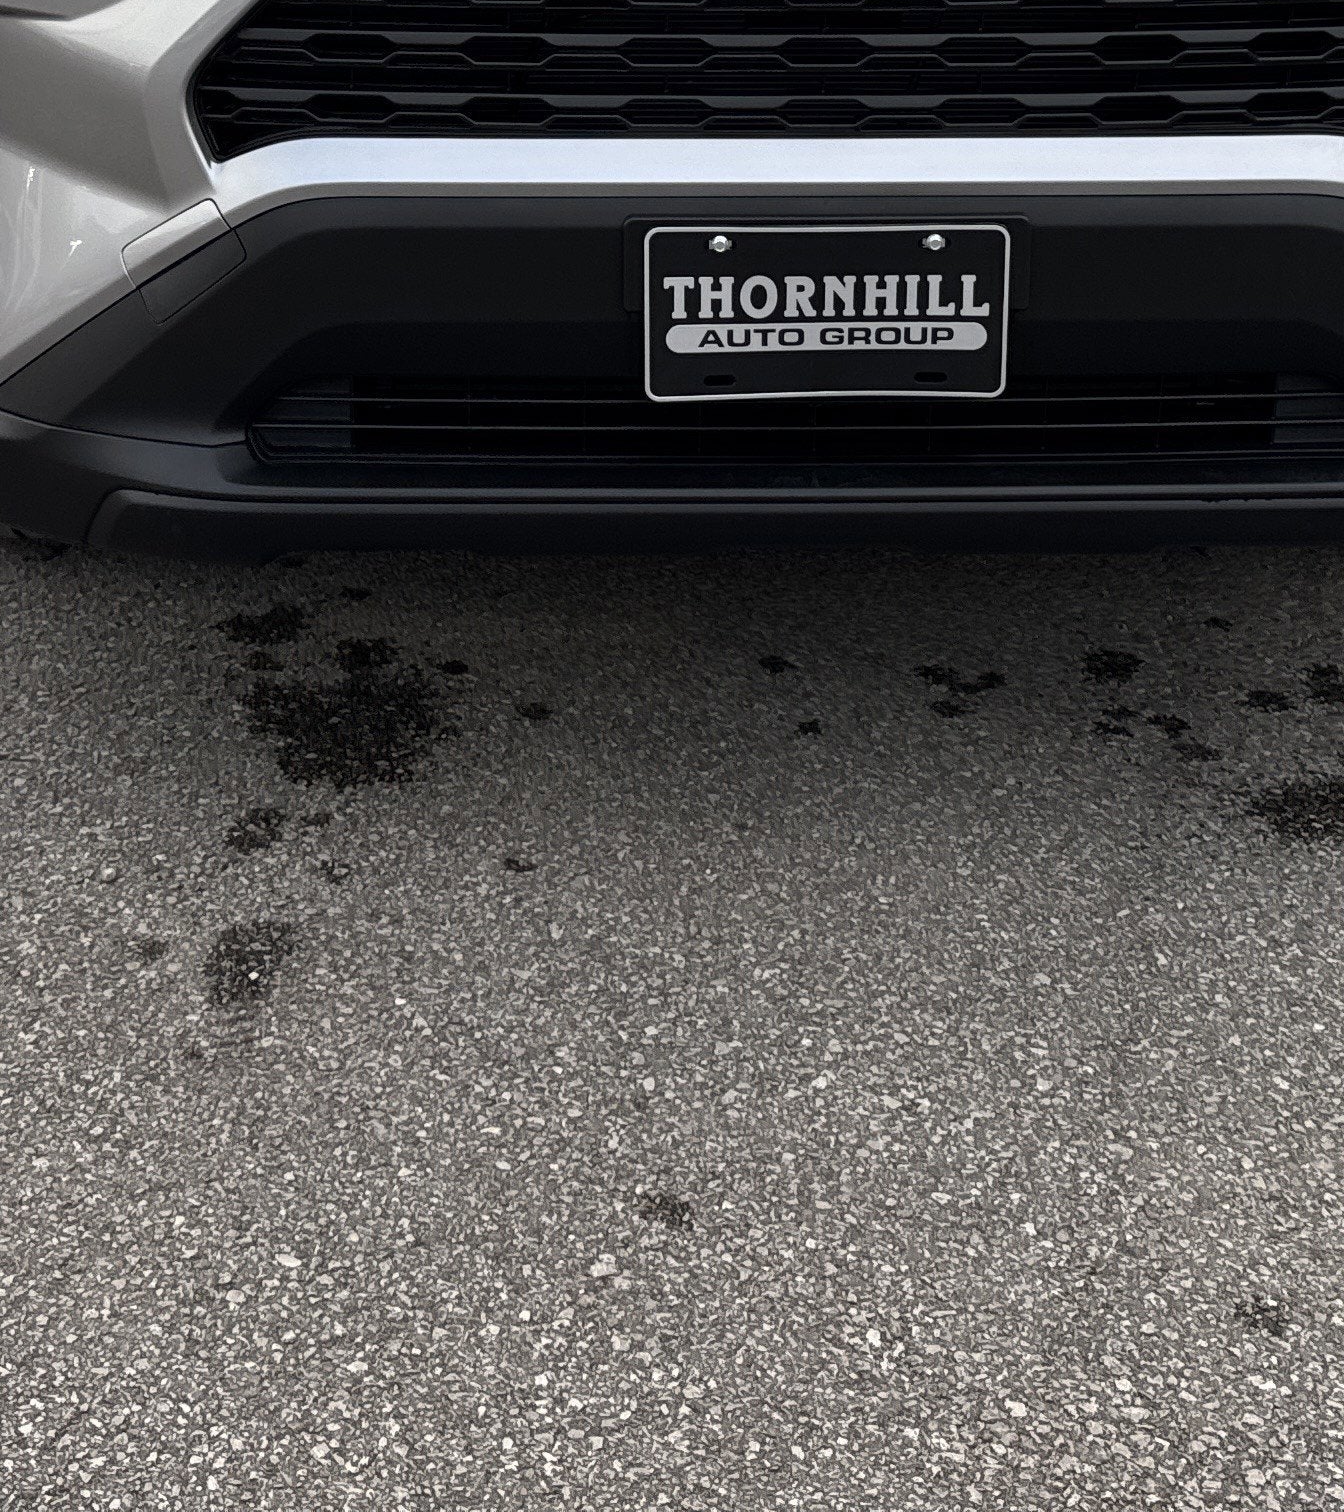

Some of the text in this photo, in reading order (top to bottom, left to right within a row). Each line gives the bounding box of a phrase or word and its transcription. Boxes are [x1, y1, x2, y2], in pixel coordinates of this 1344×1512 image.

[663, 274, 990, 319] THORNHILL
[698, 326, 954, 348] AUTO GROUP
